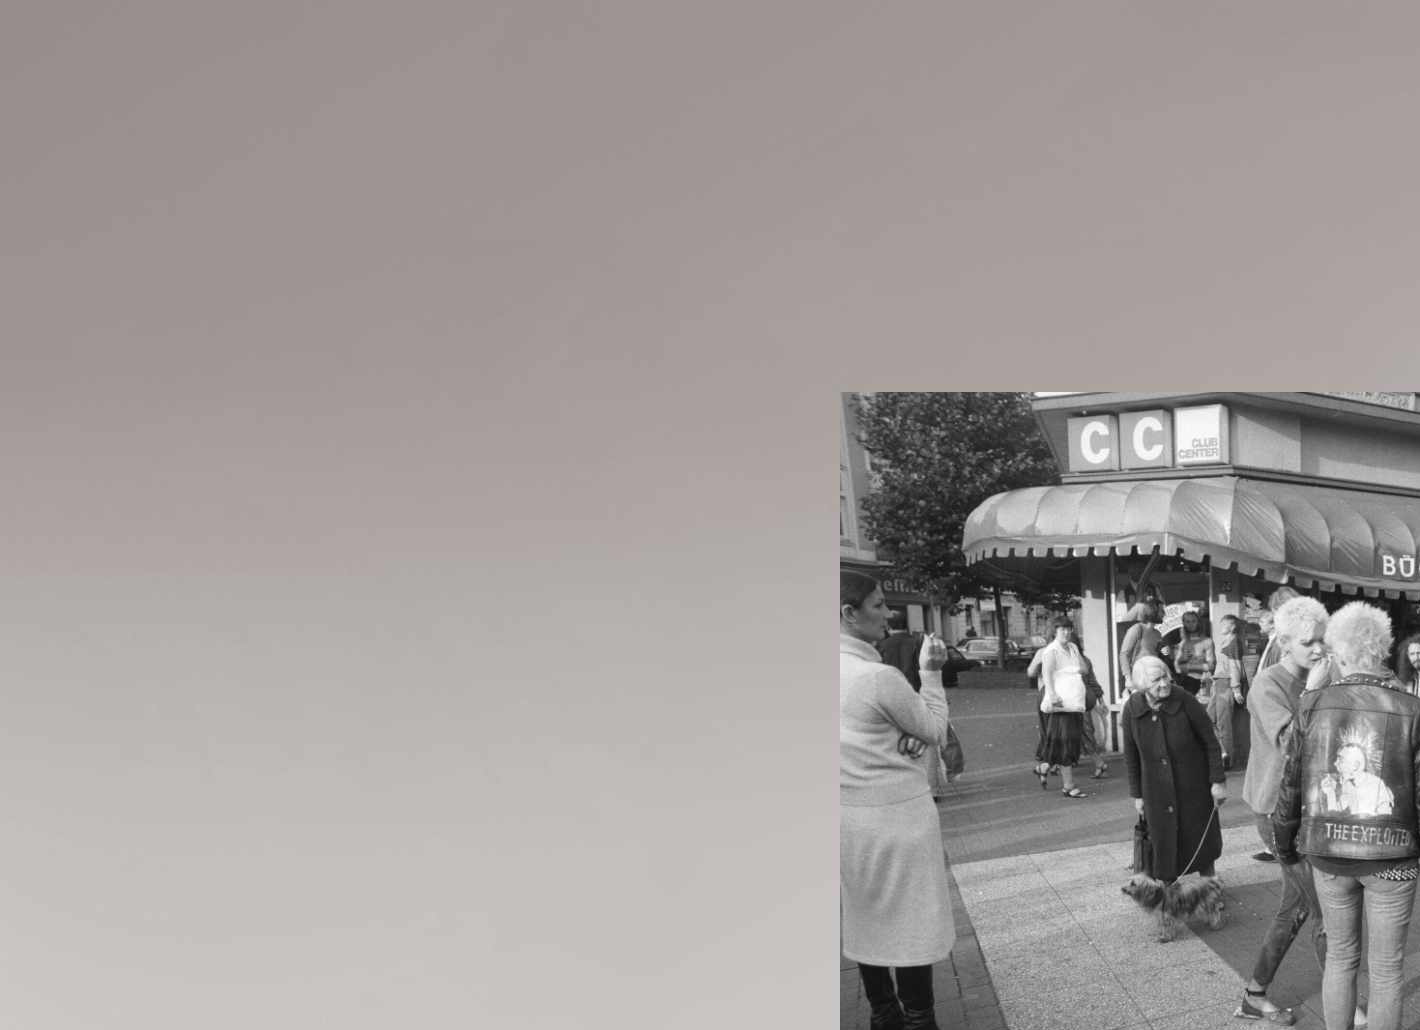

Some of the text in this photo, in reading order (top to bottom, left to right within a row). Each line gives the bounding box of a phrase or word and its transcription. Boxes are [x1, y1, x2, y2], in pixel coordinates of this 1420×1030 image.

[1081, 416, 1164, 464] C C
[1191, 437, 1218, 448] CLUB
[1178, 447, 1219, 459] CENTER
[1325, 822, 1350, 841] THE
